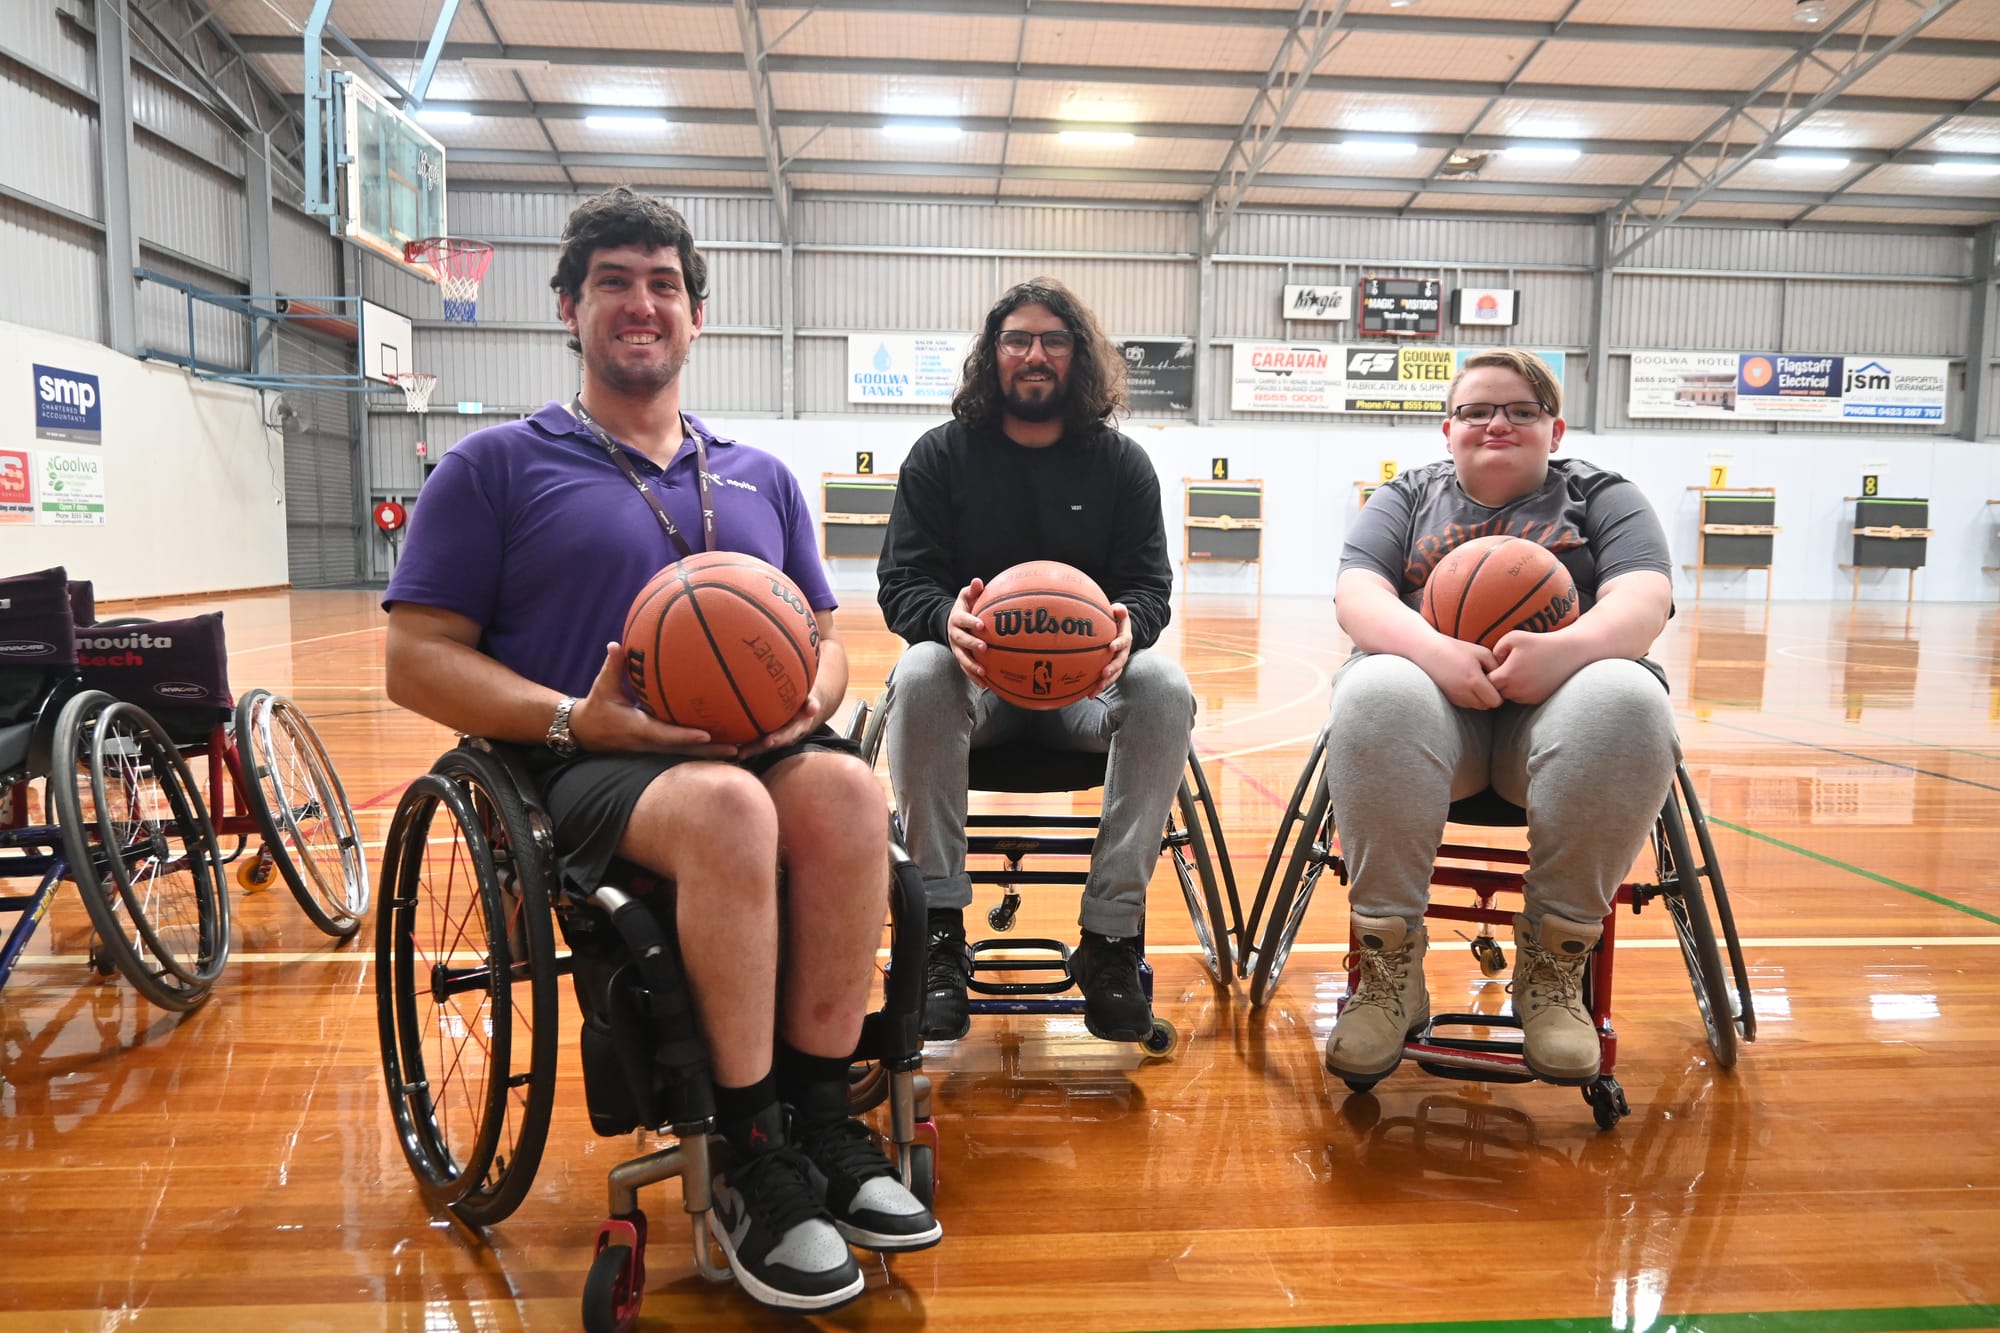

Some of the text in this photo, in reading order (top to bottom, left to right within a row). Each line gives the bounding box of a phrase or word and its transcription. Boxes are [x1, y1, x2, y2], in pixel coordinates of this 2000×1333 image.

[1251, 352, 1328, 369] CARAVAN
[1403, 351, 1451, 363] GOOLWA
[1633, 355, 1736, 367] GOOLWA HOTEL
[1403, 363, 1450, 380] STEEL
[1777, 357, 1832, 375] Flagstaff
[854, 373, 909, 385] GOOLWA
[1347, 383, 1407, 391] FABRICATION
[1779, 374, 1829, 388] Electrical
[1845, 369, 1890, 392] jsm
[39, 375, 96, 415] smp
[862, 385, 904, 397] TANKS
[42, 403, 78, 415] CHARTERED
[1845, 406, 1877, 415] PHONE
[42, 412, 86, 424] ACCOUNTANTS
[53, 455, 98, 473] Goolwa
[858, 453, 870, 473] 2
[1213, 459, 1225, 478] 4
[1384, 463, 1394, 480] 5
[1713, 468, 1723, 485] 7
[1864, 477, 1876, 495] 8
[993, 607, 1095, 638] Wilson
[75, 632, 172, 650] novita
[78, 651, 144, 667] tech
